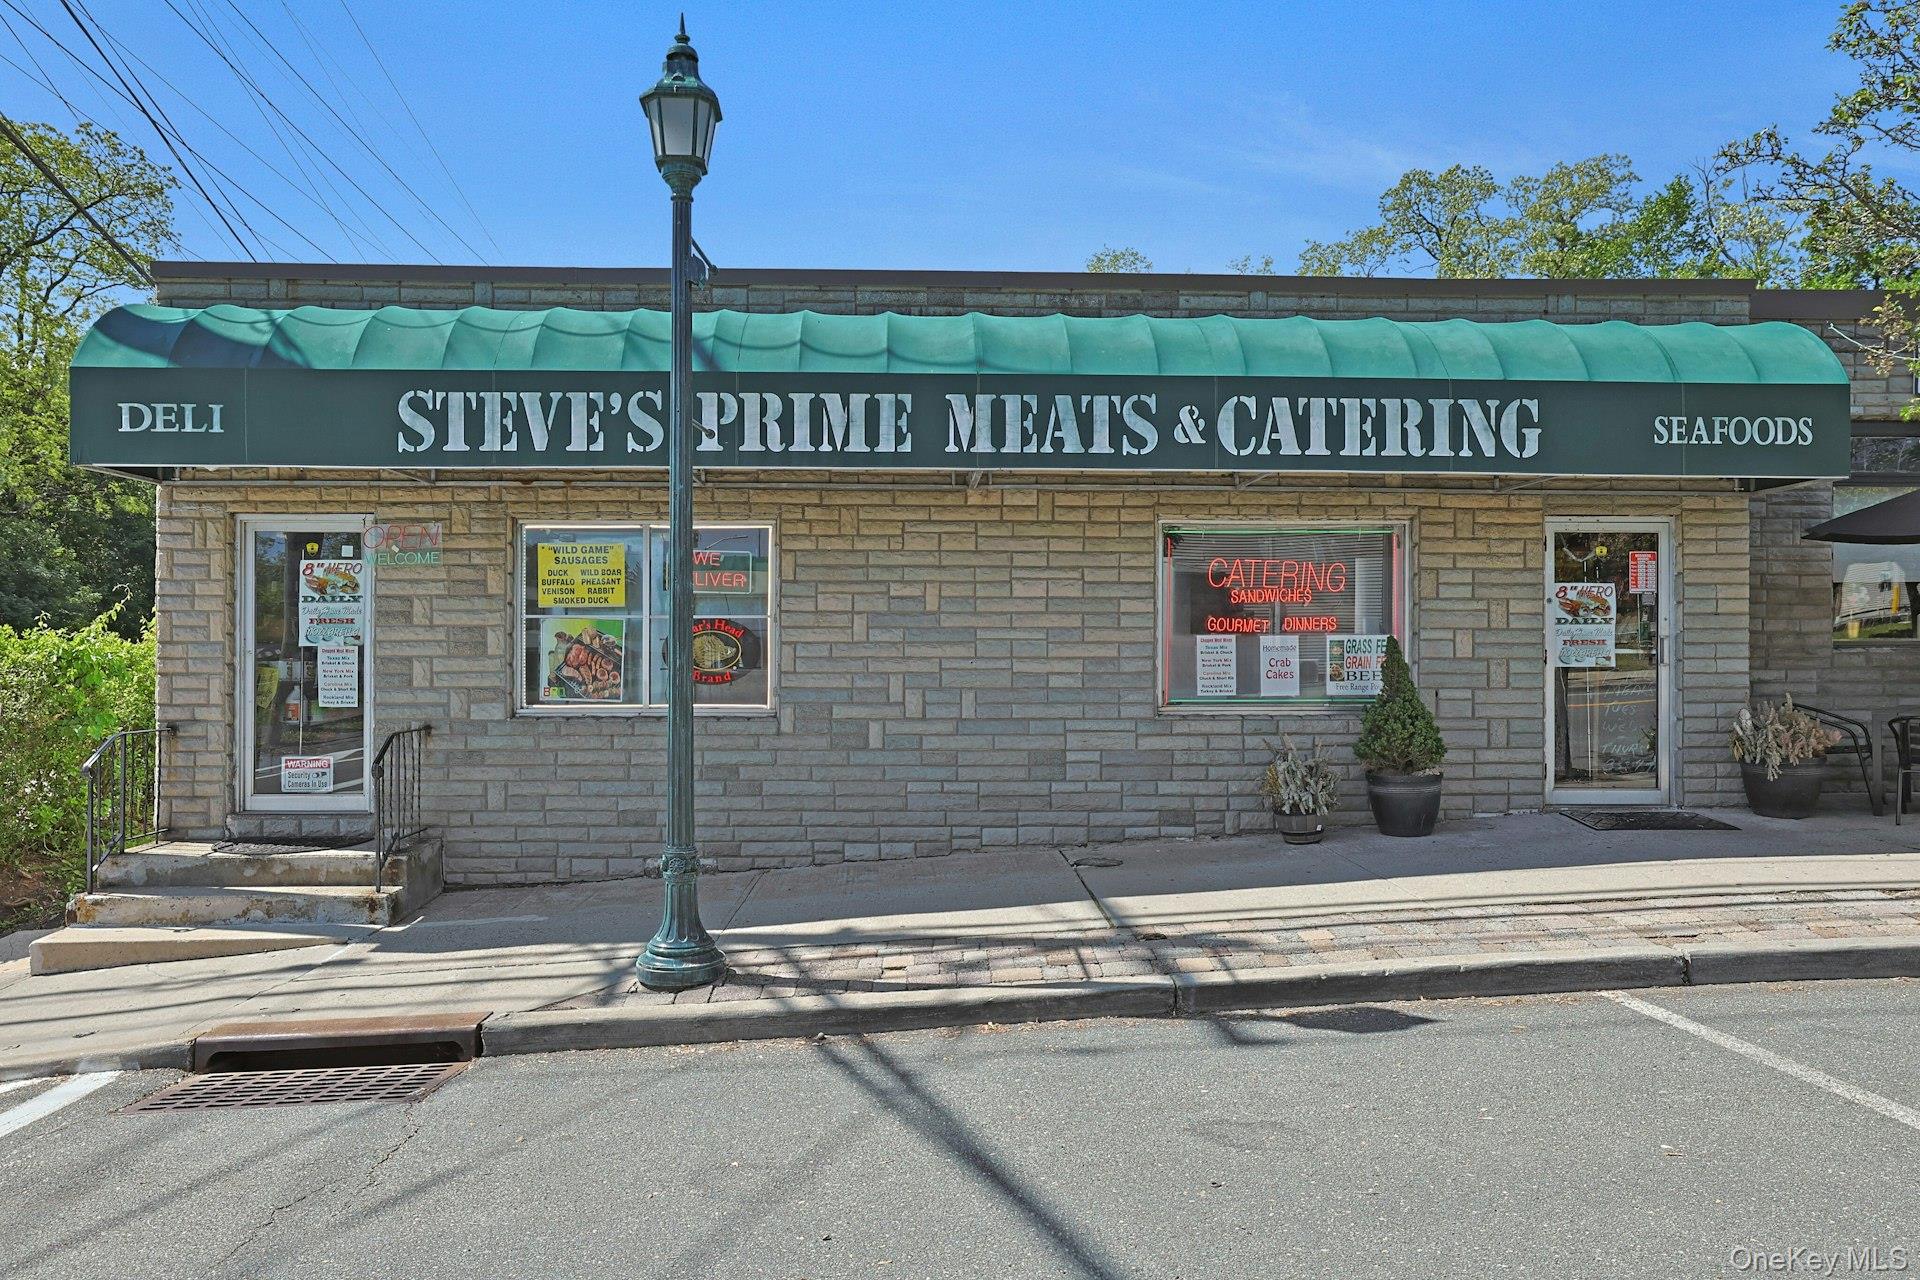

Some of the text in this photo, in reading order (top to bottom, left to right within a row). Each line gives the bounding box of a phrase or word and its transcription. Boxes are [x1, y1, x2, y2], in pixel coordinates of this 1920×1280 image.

[117, 402, 225, 434] DELI
[396, 388, 1542, 460] STEVE'S PRIME MEATS & CATERING
[1653, 415, 1815, 447] SEAFOODS
[363, 524, 440, 549] OPEN
[364, 551, 441, 566] WELCOME
[554, 556, 608, 565] SAUSAGES
[693, 552, 721, 566] WE
[325, 562, 363, 575] HERO
[547, 569, 569, 577] DUCK
[693, 572, 745, 588] LIVER
[1207, 557, 1346, 593] CATERING
[541, 578, 575, 586] BUFFALO
[581, 578, 621, 586] PHEASANT
[1230, 588, 1312, 604] SANDWICHES
[1577, 585, 1613, 597] HERO
[301, 595, 364, 604] DAILY
[553, 597, 586, 605] SMOKED
[309, 617, 356, 625] FRESH
[1207, 616, 1337, 633] GOURMET DINNERS
[1555, 617, 1614, 625] DAILY
[714, 620, 744, 639] Head
[1345, 639, 1388, 654] GRASS FE
[1268, 657, 1291, 668] Crab
[1345, 655, 1373, 670] GRAIN
[692, 671, 731, 682] Brand
[1265, 669, 1295, 679] Cakes
[1345, 670, 1383, 682] BEE
[1335, 683, 1349, 691] Free
[1350, 683, 1369, 693] Range
[286, 760, 329, 768] WARNING
[287, 771, 311, 780] Security
[287, 780, 310, 788] Cameras
[318, 780, 327, 788] Use
